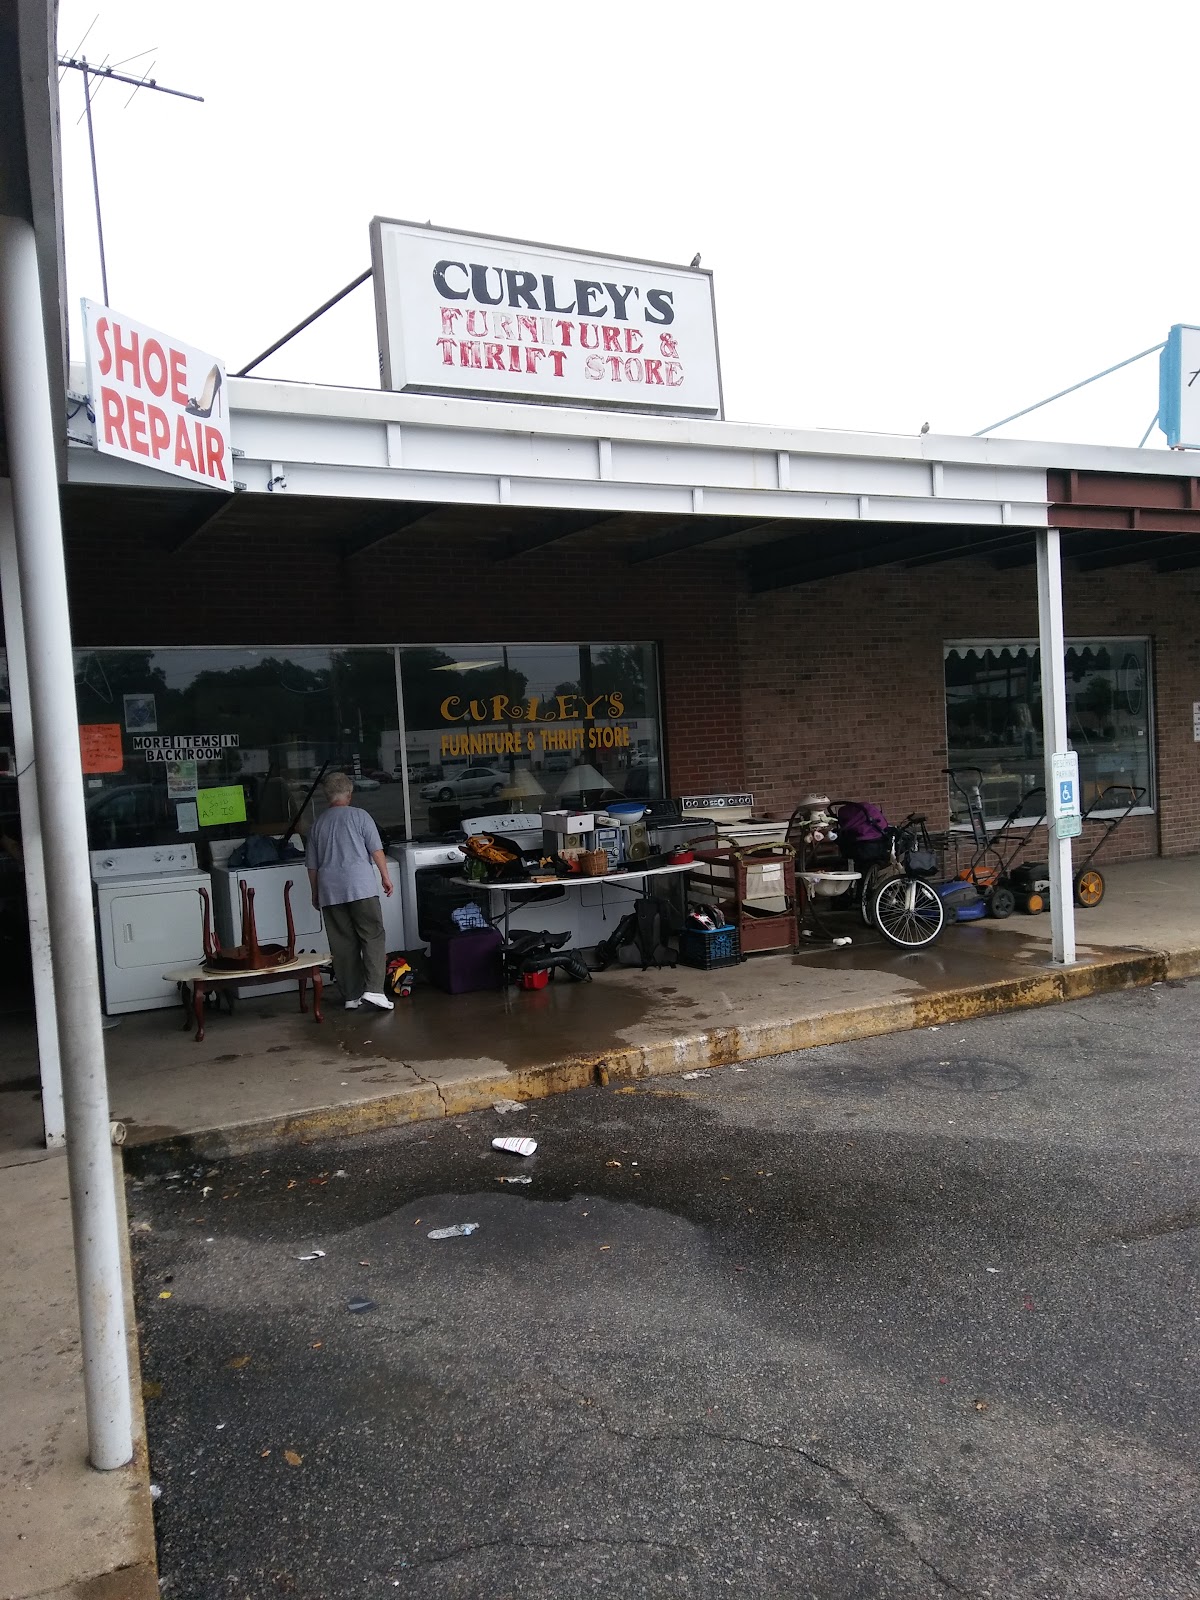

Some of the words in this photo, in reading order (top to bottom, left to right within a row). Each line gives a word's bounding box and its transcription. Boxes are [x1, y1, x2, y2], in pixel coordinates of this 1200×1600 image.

[432, 259, 675, 325] CURLEY'S
[439, 306, 644, 354] FURNITURE
[659, 332, 680, 359] &
[96, 316, 190, 406] SHOE
[435, 337, 568, 377] THRIFT
[584, 353, 684, 387] STORE
[100, 385, 227, 482] REPAIR
[440, 691, 625, 722] CURLEY'S
[134, 737, 170, 749] MORE
[177, 735, 219, 748] ITEMS
[224, 735, 239, 747] IN
[146, 749, 183, 761] BACK
[187, 748, 223, 760] ROOM
[441, 731, 522, 757] FURNITURE
[526, 731, 536, 751] &
[540, 728, 586, 750] THRIFT
[588, 726, 630, 749] STORE
[1056, 768, 1076, 778] PARKING
